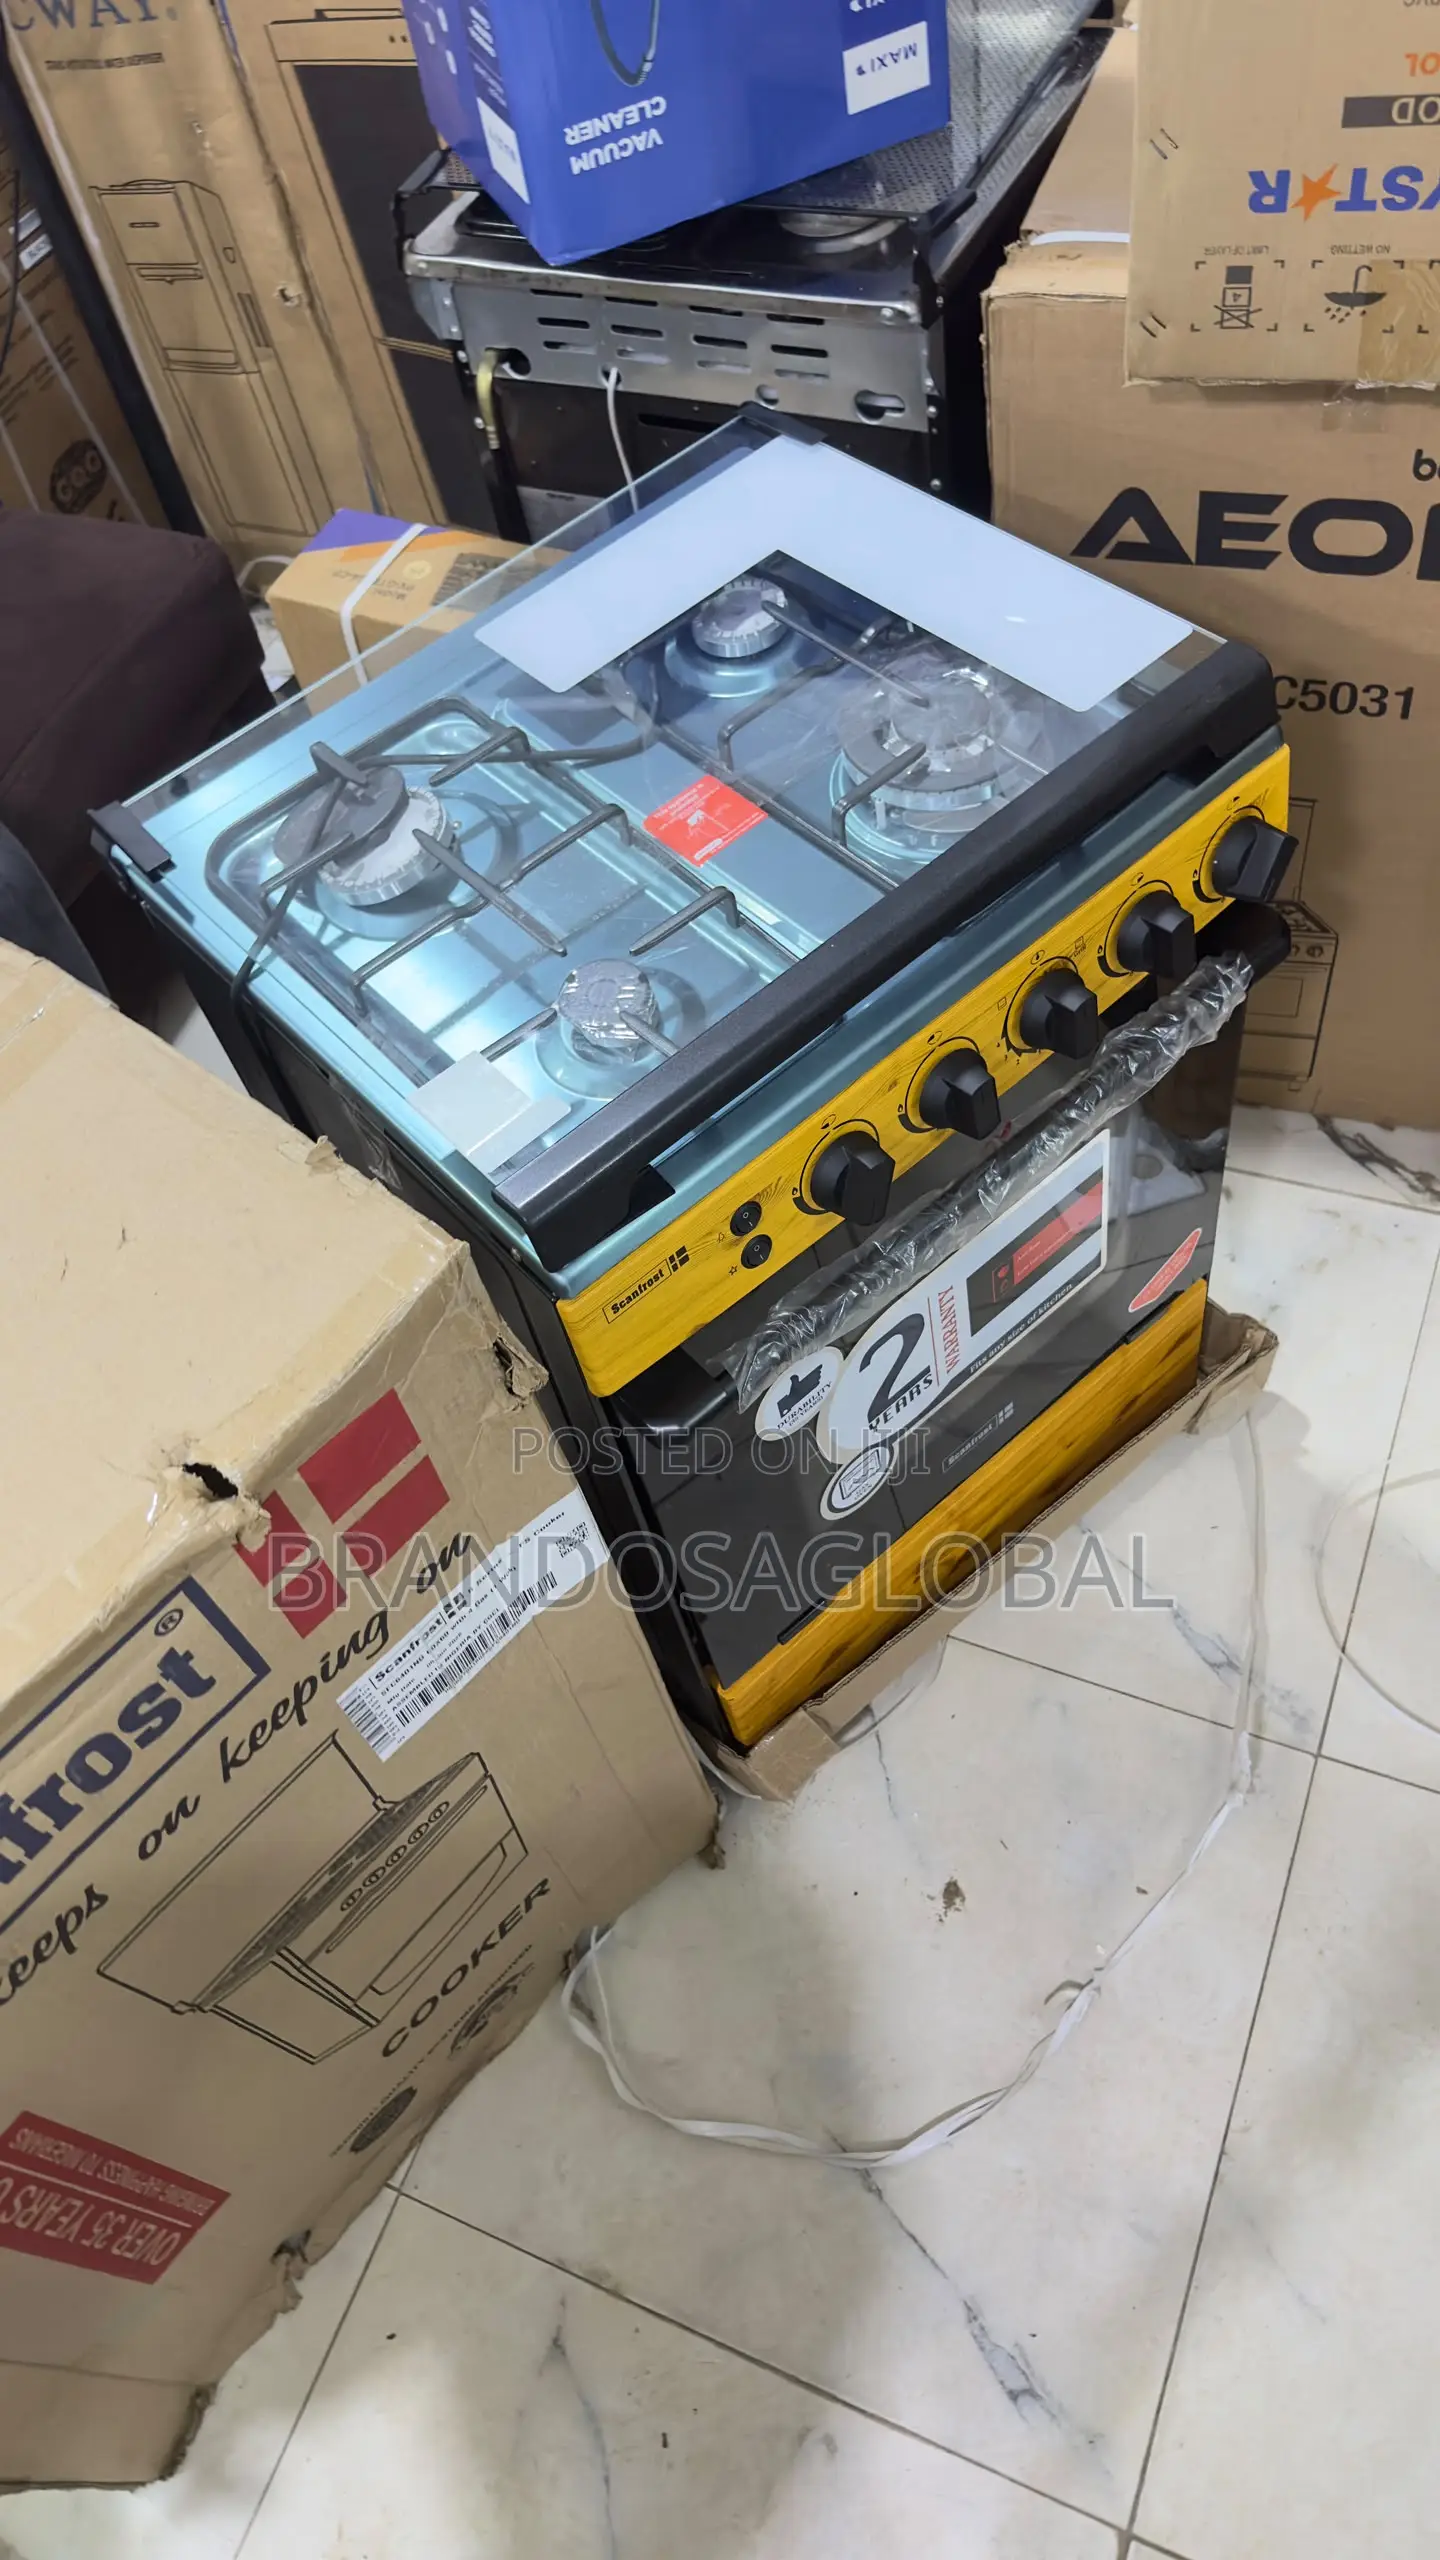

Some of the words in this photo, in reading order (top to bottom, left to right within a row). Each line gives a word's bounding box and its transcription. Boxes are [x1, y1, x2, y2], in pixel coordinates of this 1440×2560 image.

[871, 42, 917, 73] MAXI
[564, 95, 667, 146] CLEANER
[570, 128, 664, 175] VACUUM
[1330, 244, 1373, 256] WETTING
[1375, 244, 1391, 255] NO
[611, 1267, 665, 1314] Scanfrost
[937, 1284, 960, 1374] WARRANTY
[970, 1357, 988, 1374] Fits
[988, 1340, 1006, 1358] any
[1006, 1326, 1026, 1343] size
[1026, 1312, 1038, 1326] of
[1037, 1284, 1073, 1318] kitchen
[859, 1313, 931, 1424] 2
[776, 1381, 832, 1429] DURABILITY
[868, 1373, 933, 1432] YEARS
[948, 1422, 993, 1465] Scanfrost
[373, 1616, 443, 1682] Scanfrost
[0, 1884, 109, 1999] eeps
[138, 1793, 200, 1861] on
[219, 1606, 391, 1783] keeping
[416, 1530, 473, 1596] on
[382, 1876, 551, 2059] COOKER
[0, 2185, 95, 2243] YEARS
[81, 2210, 126, 2249] 35
[111, 2217, 181, 2266] OVER
